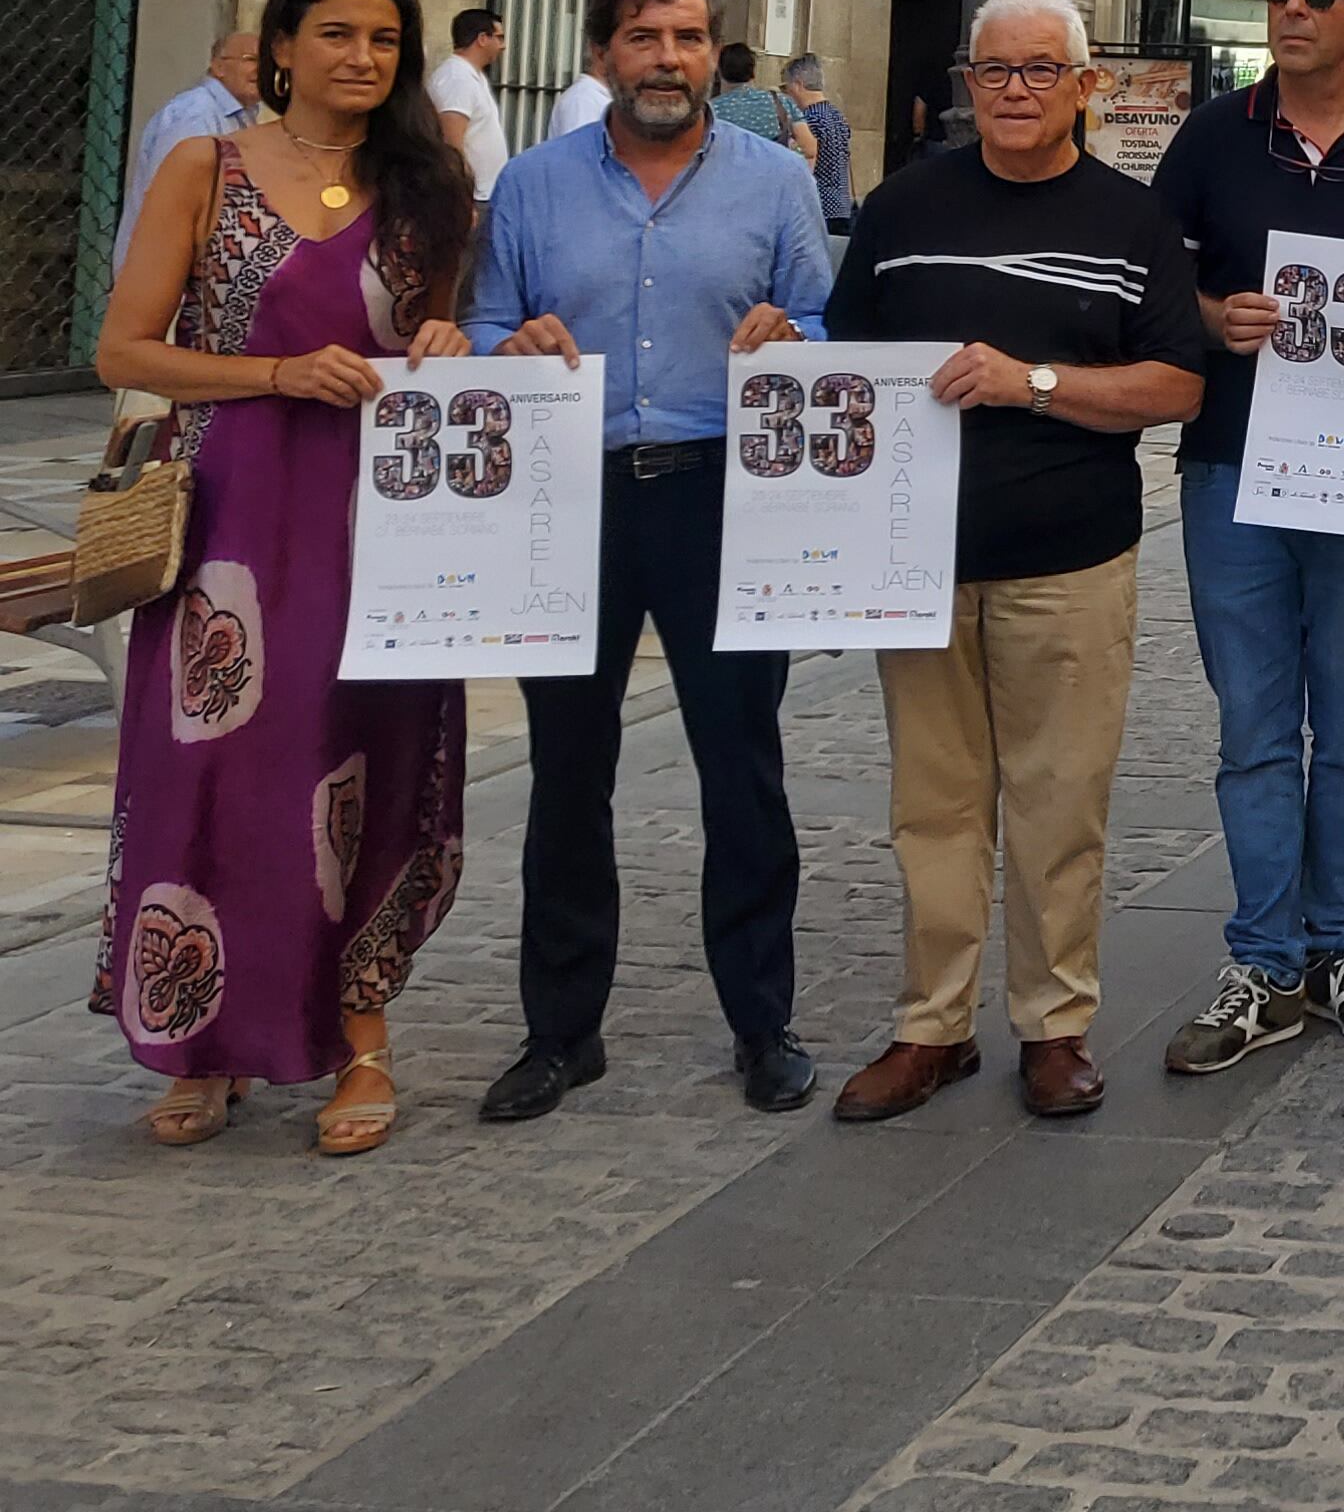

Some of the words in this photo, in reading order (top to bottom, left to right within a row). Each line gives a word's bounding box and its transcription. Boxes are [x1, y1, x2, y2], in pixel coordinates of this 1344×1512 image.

[1104, 113, 1180, 125] DESAYUNO
[1125, 127, 1159, 136] OFERTA
[1120, 140, 1162, 149] TOSTADA,
[509, 392, 581, 403] ANIVERSARIO
[739, 373, 875, 478] 33
[372, 389, 512, 500] 33
[871, 565, 943, 590] JAÉN
[510, 588, 586, 615] JAÉN
